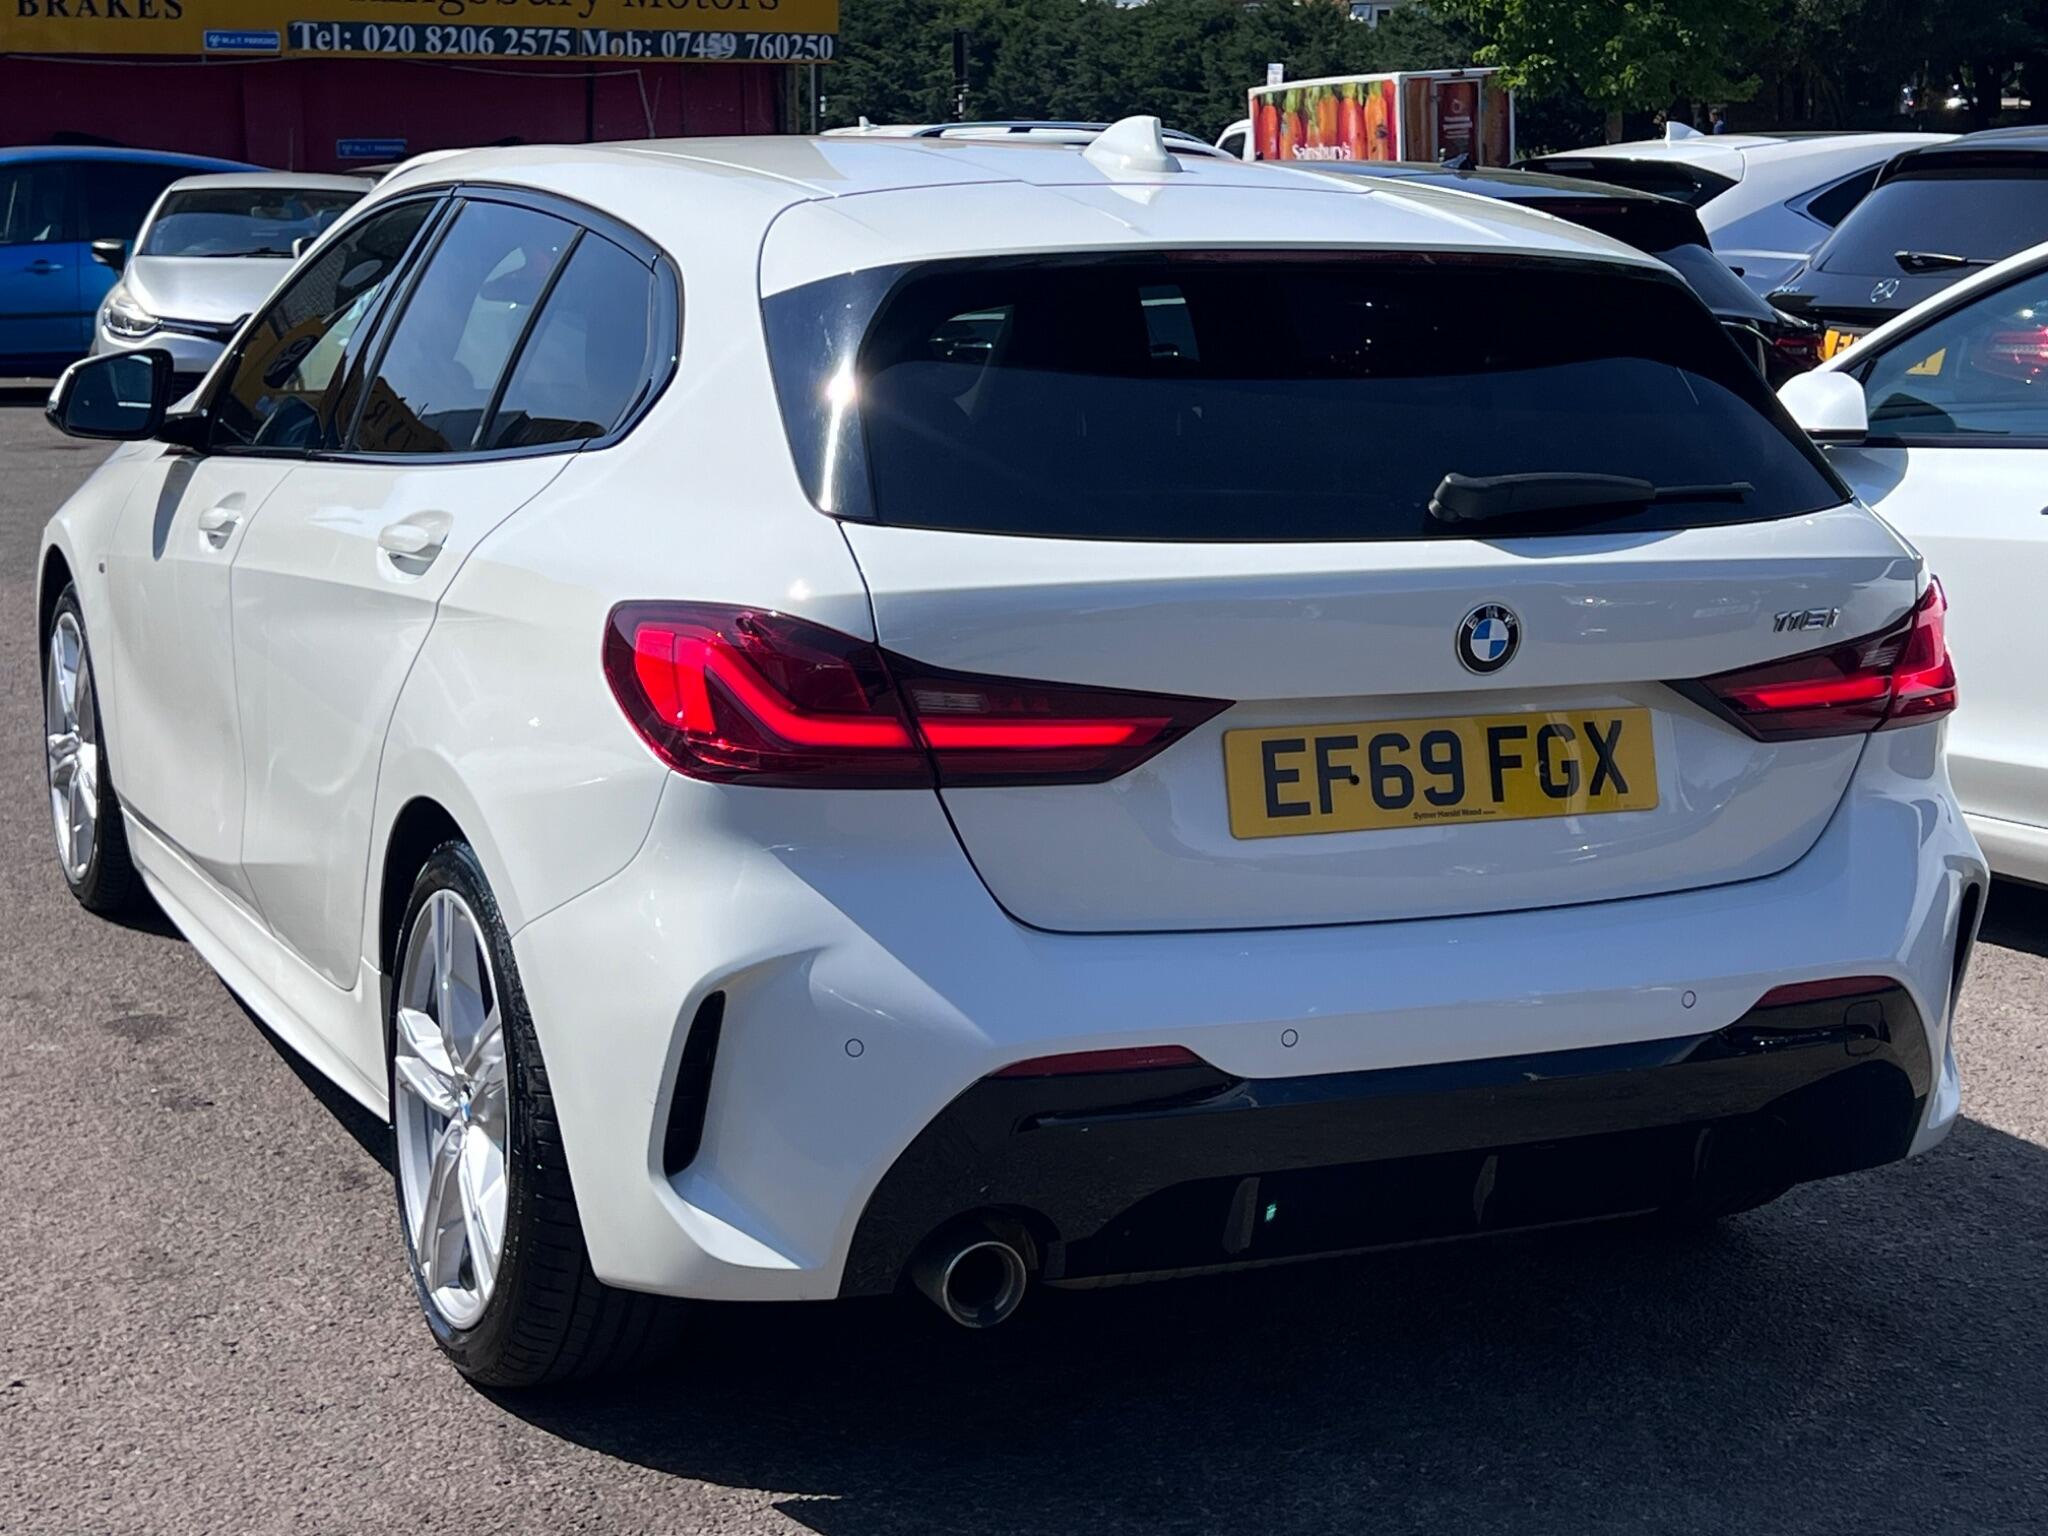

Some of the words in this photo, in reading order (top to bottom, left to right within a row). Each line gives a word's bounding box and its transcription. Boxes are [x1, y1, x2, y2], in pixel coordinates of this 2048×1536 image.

[16, 0, 184, 19] BRAKES
[292, 21, 352, 51] Tel:
[362, 24, 416, 52] 020
[425, 26, 495, 55] 8206
[504, 29, 571, 57] 2575
[580, 30, 652, 57] Mob:
[745, 34, 834, 61] 760250
[1465, 605, 1517, 630] BMW
[1261, 730, 1466, 819] EF69
[1486, 719, 1630, 803] FGX
